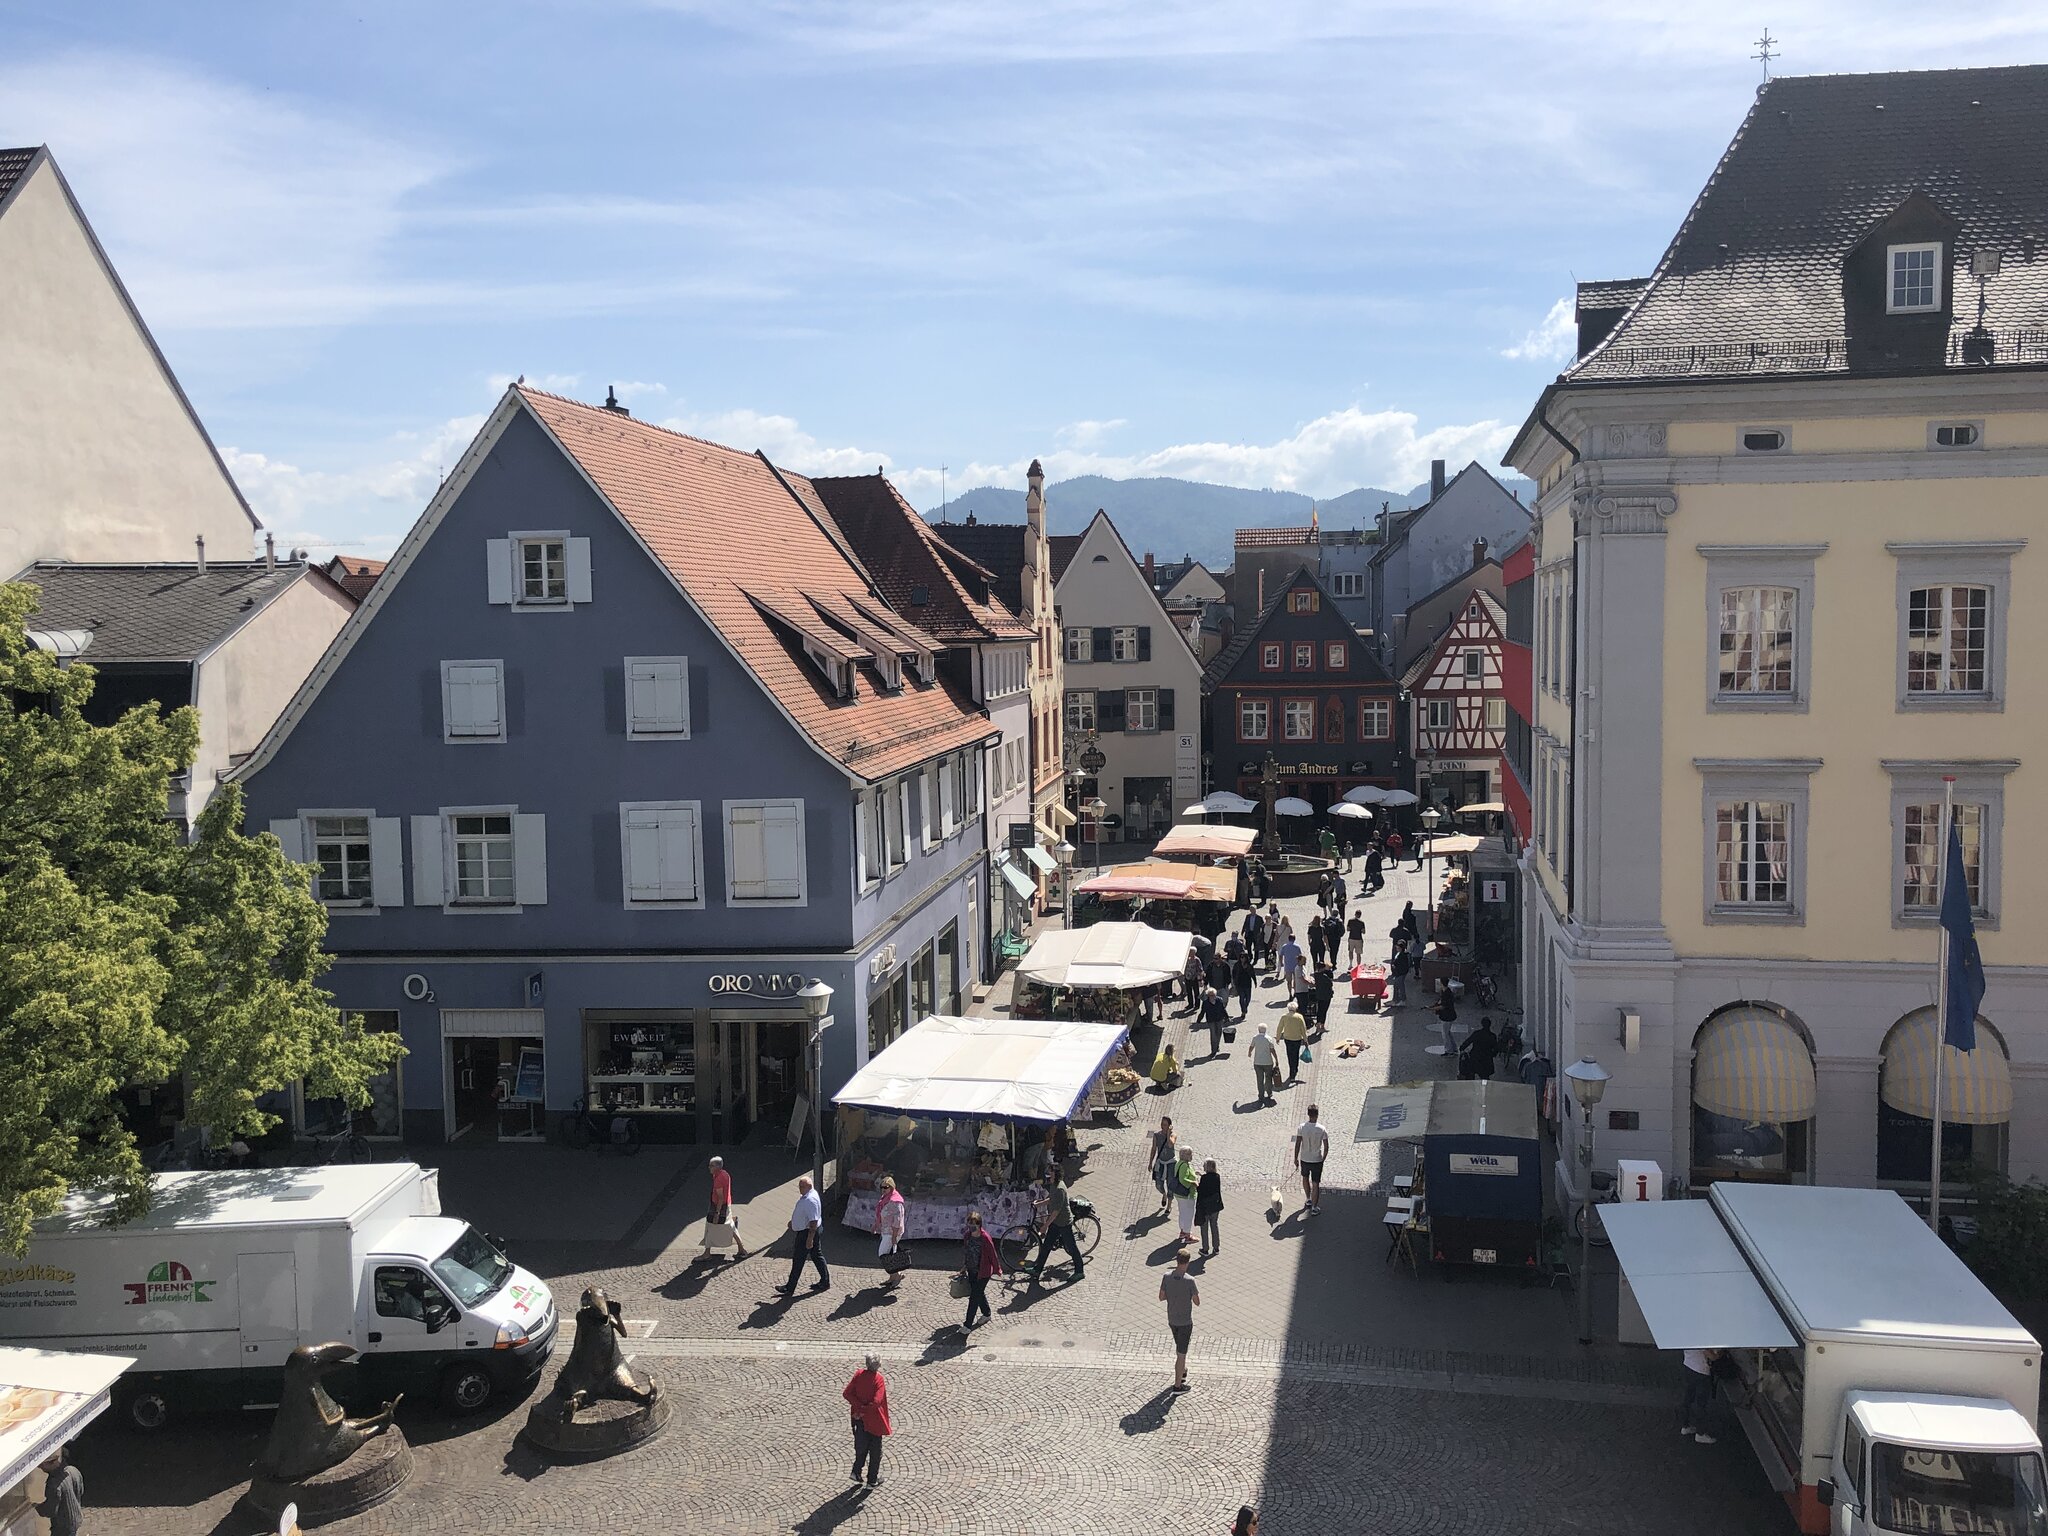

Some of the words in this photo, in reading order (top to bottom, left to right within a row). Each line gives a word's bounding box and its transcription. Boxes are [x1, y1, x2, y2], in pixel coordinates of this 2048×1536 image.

[1181, 738, 1191, 746] S1
[1299, 761, 1338, 775] Andres
[708, 974, 752, 993] ORO
[757, 974, 806, 992] VIVO
[614, 1033, 666, 1043] EWKEIT
[148, 1291, 192, 1303] Lindenhof
